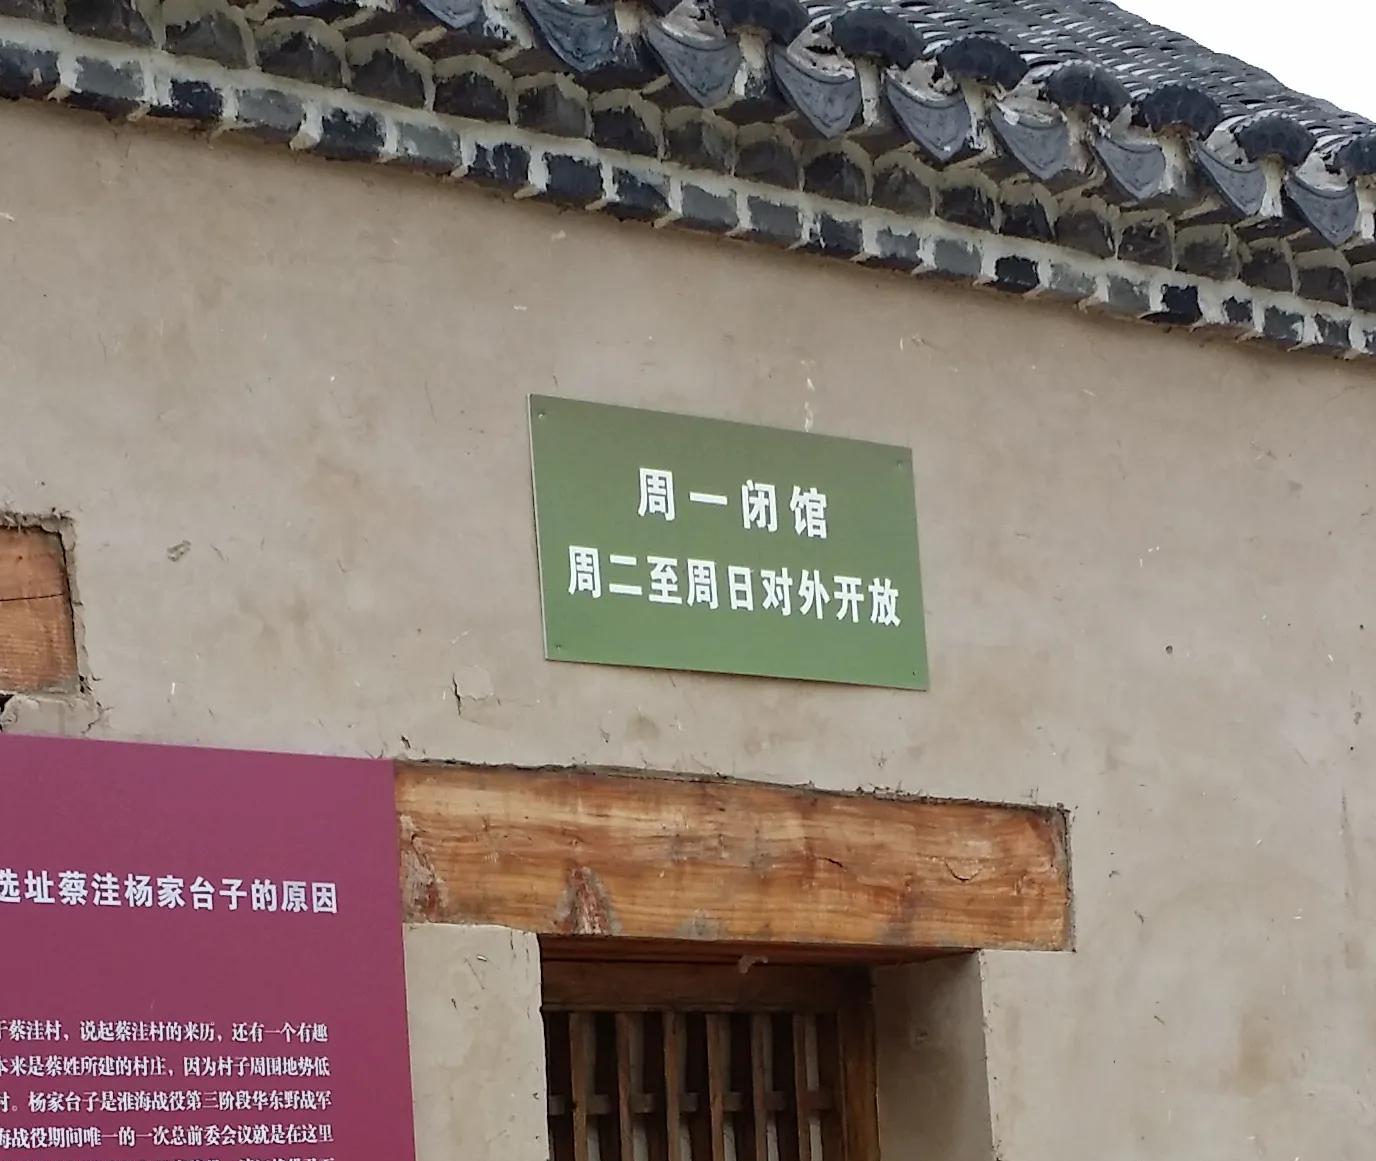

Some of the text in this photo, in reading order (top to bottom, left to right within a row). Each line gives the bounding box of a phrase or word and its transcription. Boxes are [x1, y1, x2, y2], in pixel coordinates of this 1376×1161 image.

[638, 467, 828, 539] 周一闭馆
[568, 544, 902, 627] 周二至周日对外开放
